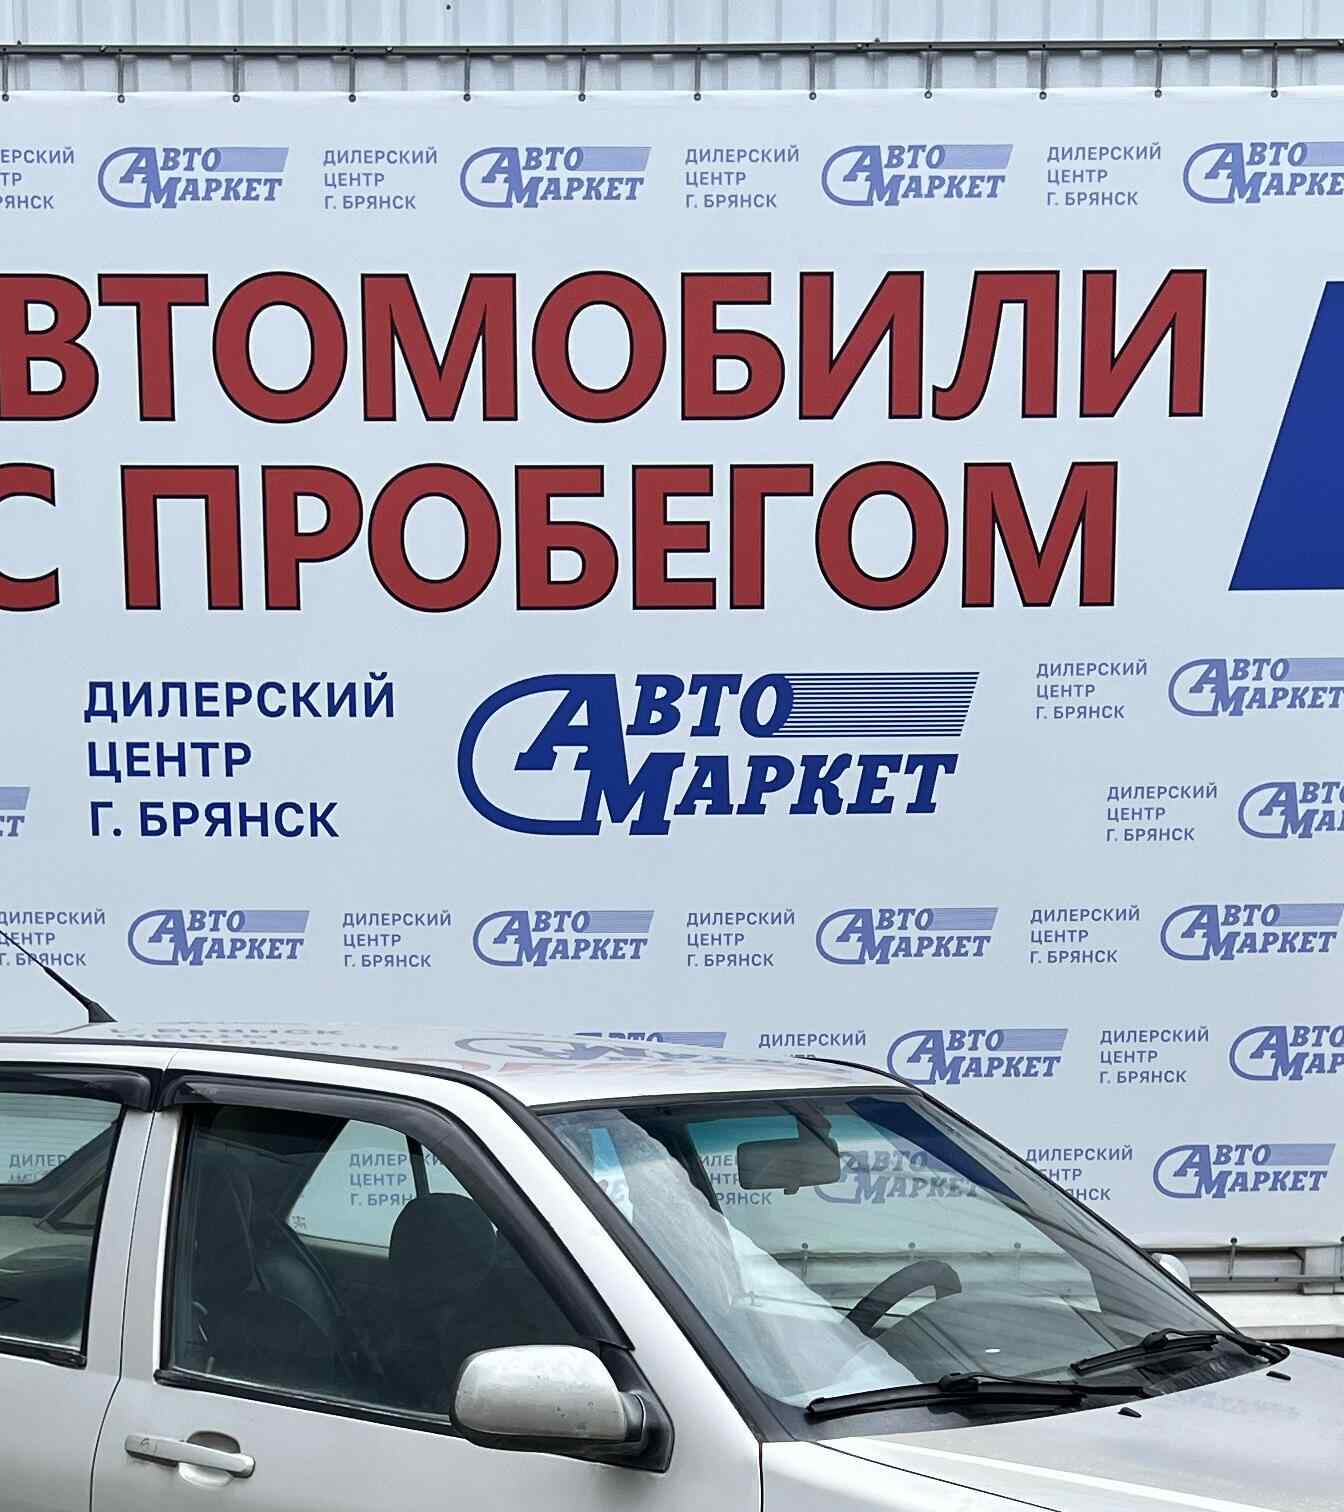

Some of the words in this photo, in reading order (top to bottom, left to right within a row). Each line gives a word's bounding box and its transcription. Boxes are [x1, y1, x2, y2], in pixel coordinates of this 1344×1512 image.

[323, 146, 437, 166] ДИЛЕРСКИЙ
[685, 145, 799, 165] ДИЛЕРСКИЙ
[1047, 142, 1161, 163] ДИЛЕРСКИЙ
[324, 172, 384, 189] ЦЕНТР
[686, 171, 746, 188] ЦЕНТР
[1048, 169, 1108, 186] ЦЕНТР
[325, 196, 336, 209] Г.
[343, 195, 416, 209] БРЯНСК
[686, 194, 697, 208] Г.
[704, 194, 776, 208] БРЯНСК
[1048, 192, 1058, 205] Г.
[1065, 192, 1138, 206] БРЯНСК
[120, 461, 1118, 613] ПРОБЕГОМ
[1036, 659, 1147, 679] ДИЛЕРСКИЙ
[84, 672, 394, 723] ДИЛЕРСКИЙ
[1037, 684, 1095, 700] ЦЕНТР
[1036, 706, 1047, 720] Г.
[1054, 705, 1124, 719] БРЯНСК
[88, 741, 251, 783] ЦЕНТР
[1107, 782, 1217, 802] ДИЛЕРСКИЙ
[90, 801, 122, 837] Г.
[140, 801, 339, 838] БРЯНСК
[1108, 807, 1165, 822] ЦЕНТР
[1107, 829, 1118, 842] Г.
[1124, 828, 1194, 841] БРЯНСК
[342, 910, 451, 928] ДИЛЕРСКИЙ
[687, 909, 794, 928] ДИЛЕРСКИЙ
[1030, 905, 1139, 924] ДИЛЕРСКИЙ
[344, 934, 401, 949] ЦЕНТР
[688, 933, 744, 948] ЦЕНТР
[1031, 929, 1088, 945] ЦЕНТР
[0, 953, 10, 966] Г.
[16, 953, 87, 966] БРЯНСК
[344, 955, 355, 967] Г.
[362, 955, 431, 967] БРЯНСК
[688, 954, 698, 967] Г.
[704, 953, 774, 967] БРЯНСК
[1030, 951, 1041, 964] Г.
[1048, 950, 1117, 964] БРЯНСК
[758, 1030, 866, 1048] ДИЛЕРСКИЙ
[1100, 1026, 1208, 1045] ДИЛЕРСКИЙ
[1101, 1050, 1157, 1065] ЦЕНТР
[1100, 1071, 1110, 1084] Г.
[1117, 1070, 1187, 1083] БРЯНСК
[1026, 1144, 1133, 1162] ДИЛЕРСКИЙ
[350, 1173, 406, 1188] ЦЕНТР
[350, 1193, 362, 1206] Г.
